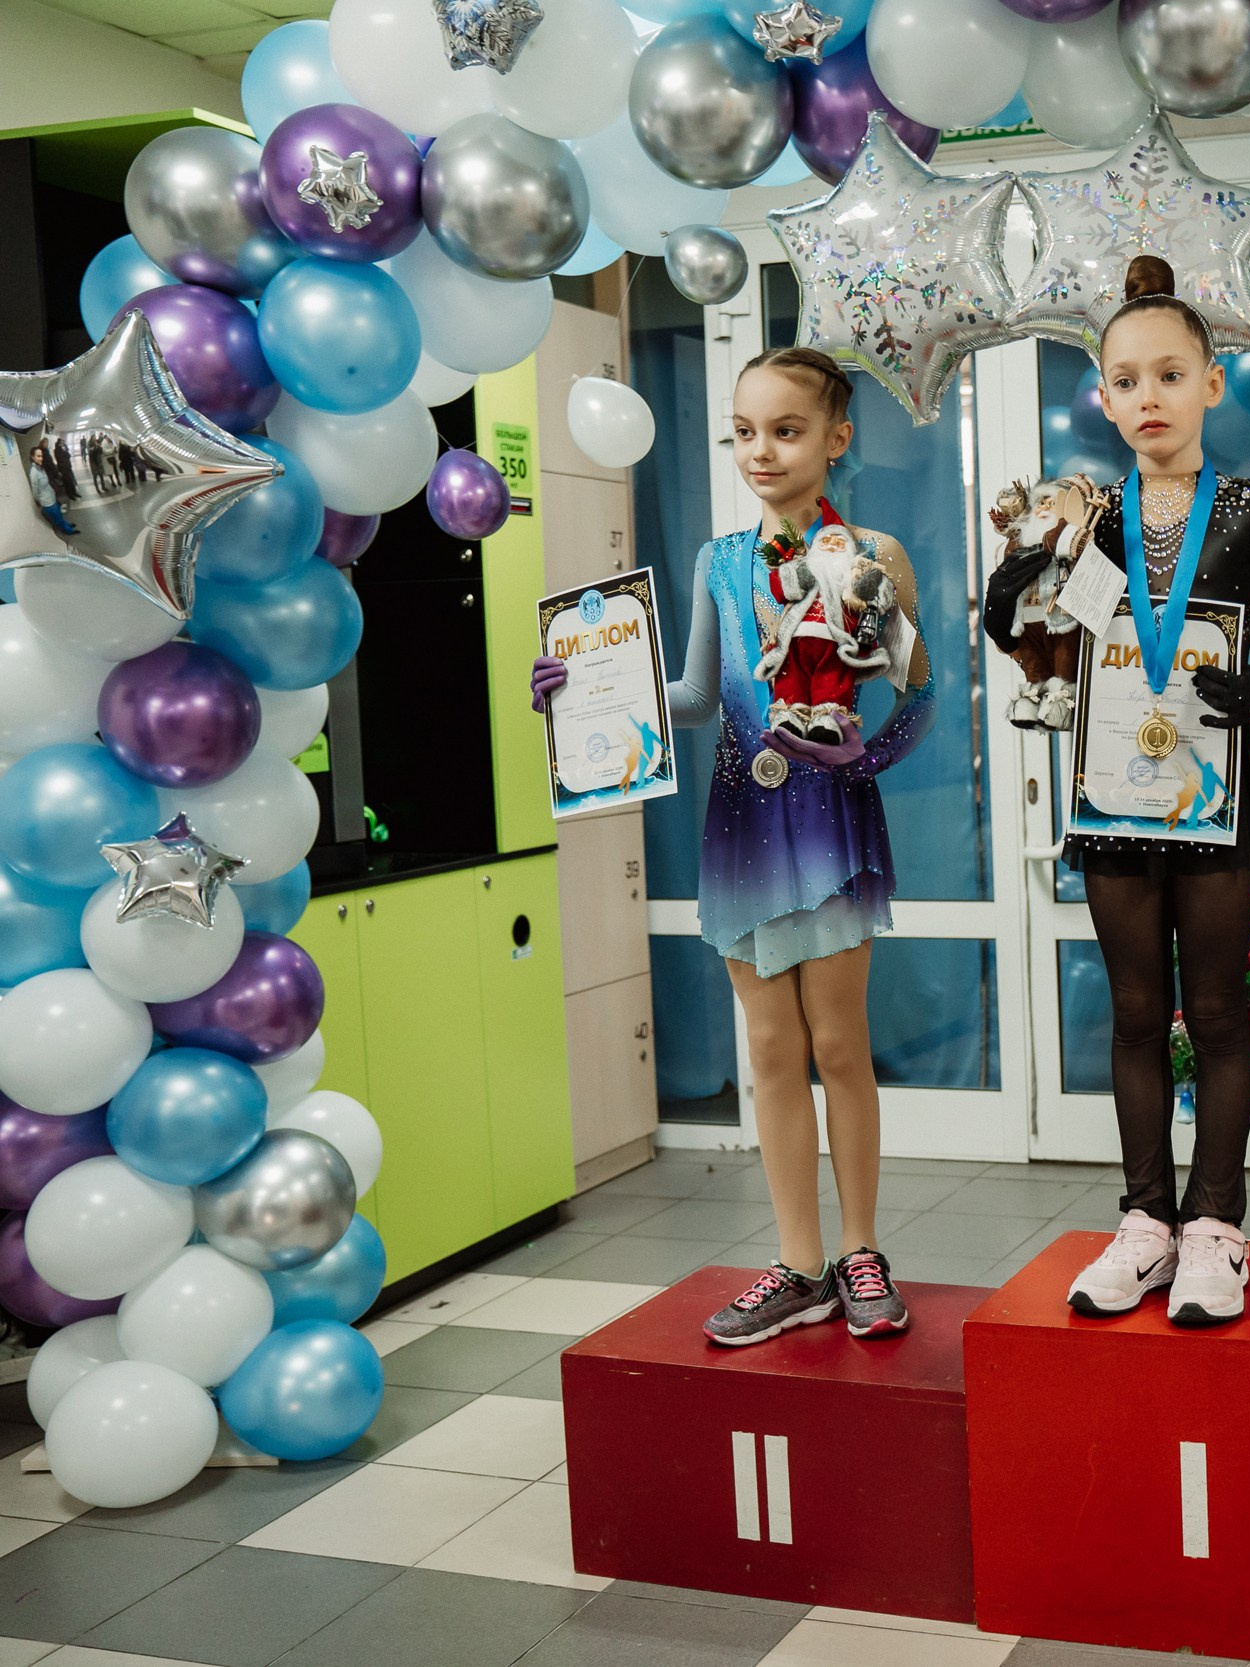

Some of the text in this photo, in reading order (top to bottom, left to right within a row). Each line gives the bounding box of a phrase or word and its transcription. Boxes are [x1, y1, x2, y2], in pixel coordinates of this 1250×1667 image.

[500, 456, 527, 479] 350
[610, 530, 623, 549] 37
[554, 618, 641, 661] ДИПЛОМ
[1100, 643, 1220, 672] ДИОМ
[1153, 729, 1163, 746] 1
[625, 860, 640, 879] 39
